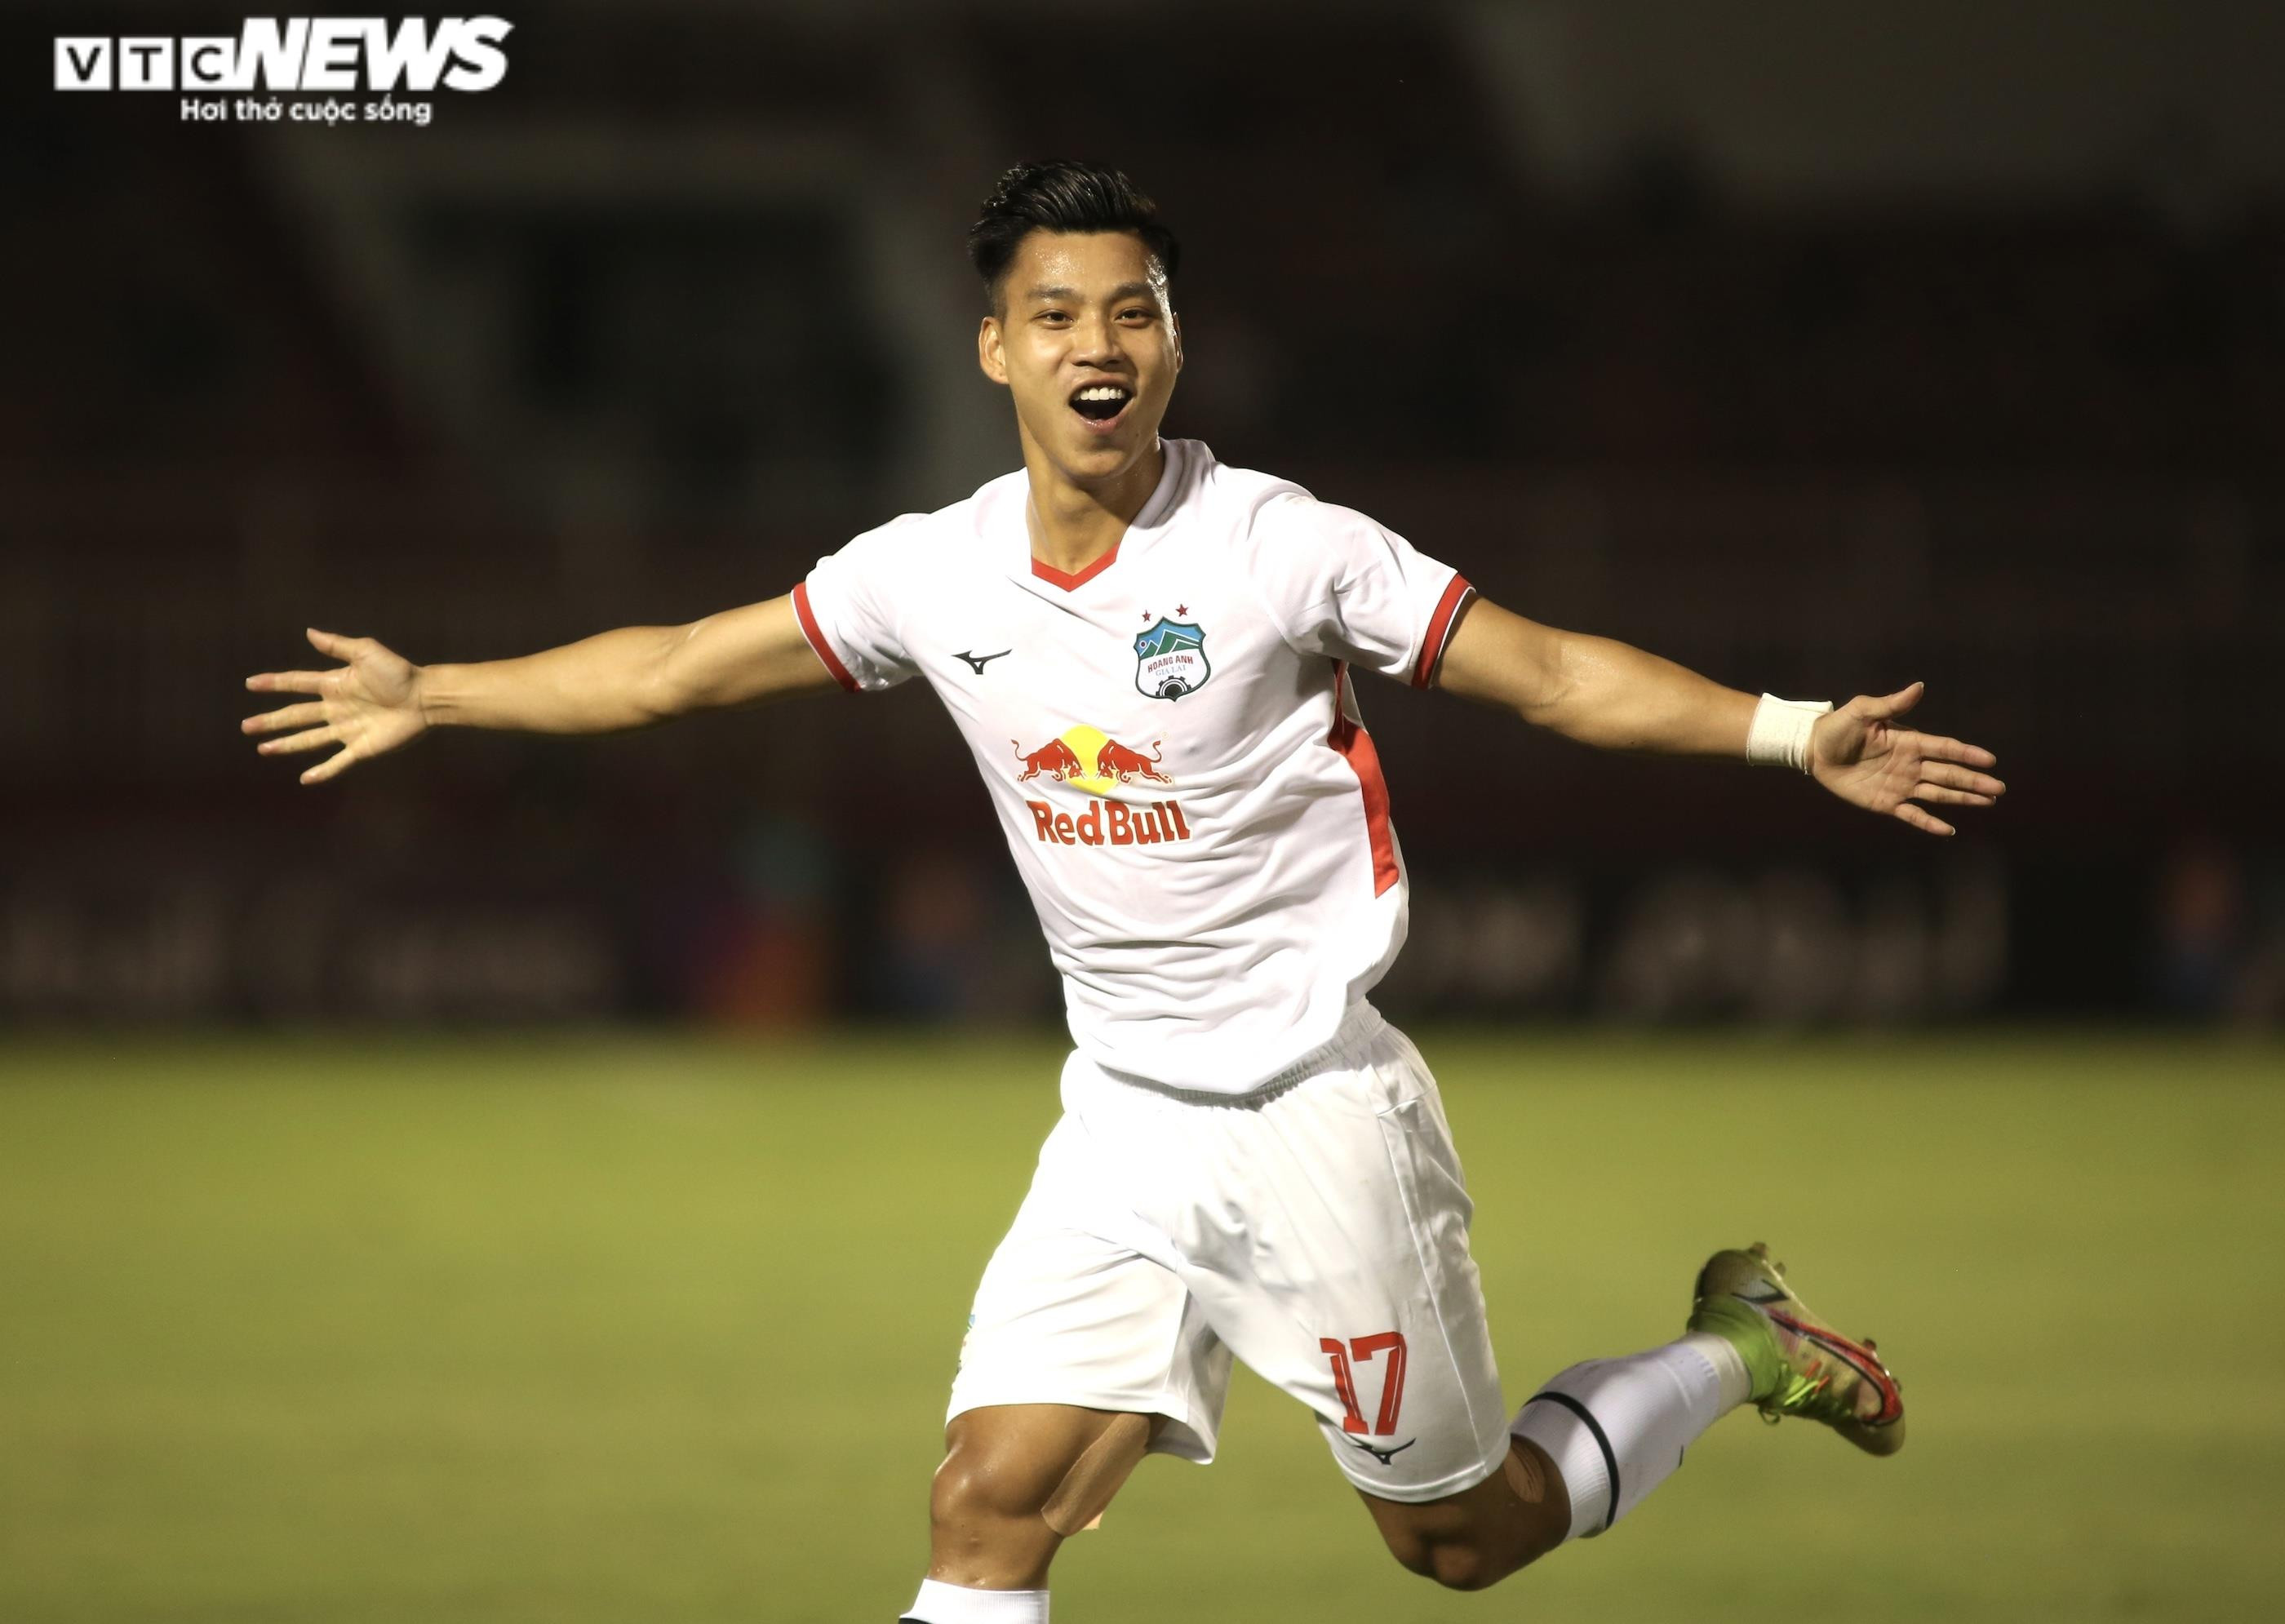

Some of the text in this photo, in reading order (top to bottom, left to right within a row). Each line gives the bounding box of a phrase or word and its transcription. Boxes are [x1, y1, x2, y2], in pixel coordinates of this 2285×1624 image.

[1147, 654, 1194, 672] HOANG ANH
[1172, 664, 1186, 672] LAI
[1025, 800, 1190, 845] Red Bull
[1319, 1331, 1408, 1435] 17
